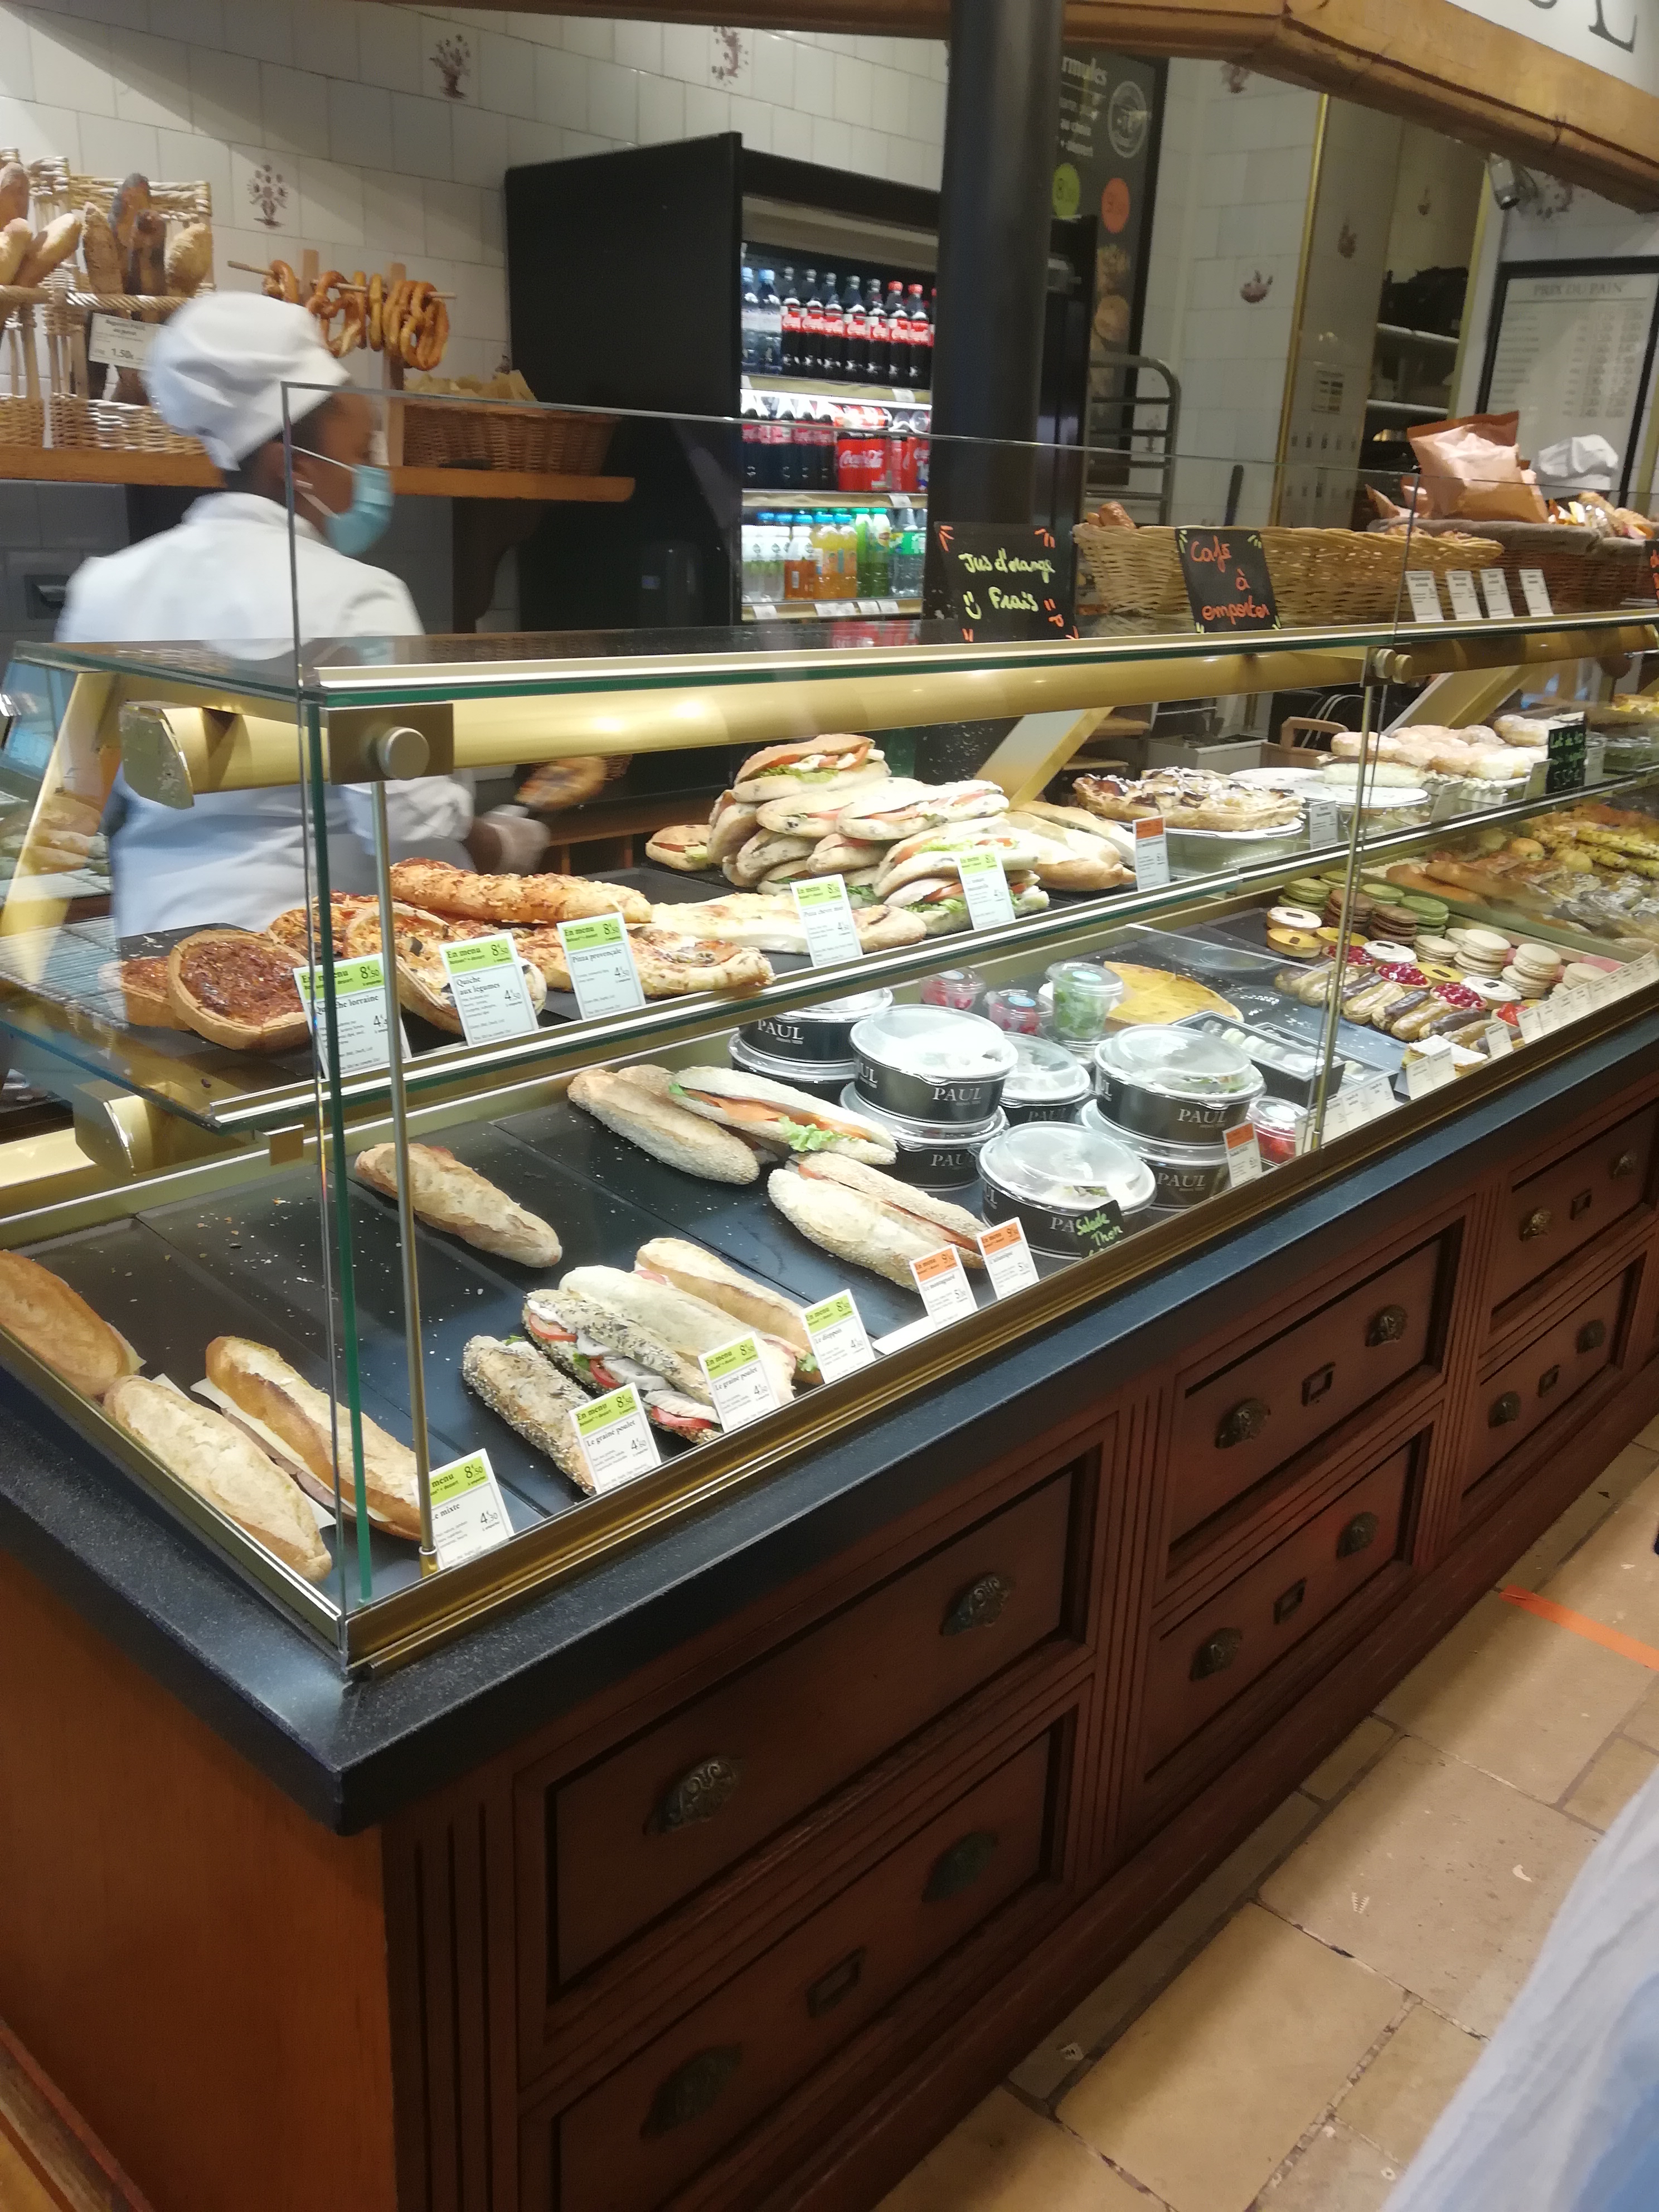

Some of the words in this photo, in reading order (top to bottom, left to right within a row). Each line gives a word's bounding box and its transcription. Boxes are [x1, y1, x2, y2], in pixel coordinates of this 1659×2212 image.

[958, 552, 993, 573] Jus
[988, 586, 1039, 612] Frais
[459, 947, 481, 957] menu
[347, 995, 379, 1006] lorraine
[757, 1019, 805, 1040] PAUL
[932, 1087, 982, 1102] PAUL
[1177, 1108, 1226, 1124] PAUL
[1157, 1172, 1206, 1187] PAUL
[1049, 1216, 1076, 1234] PA
[576, 1411, 586, 1421] En
[588, 1403, 607, 1416] menu
[617, 1420, 636, 1435] poulet
[431, 1473, 454, 1488] menu
[440, 1503, 460, 1517] mixte
